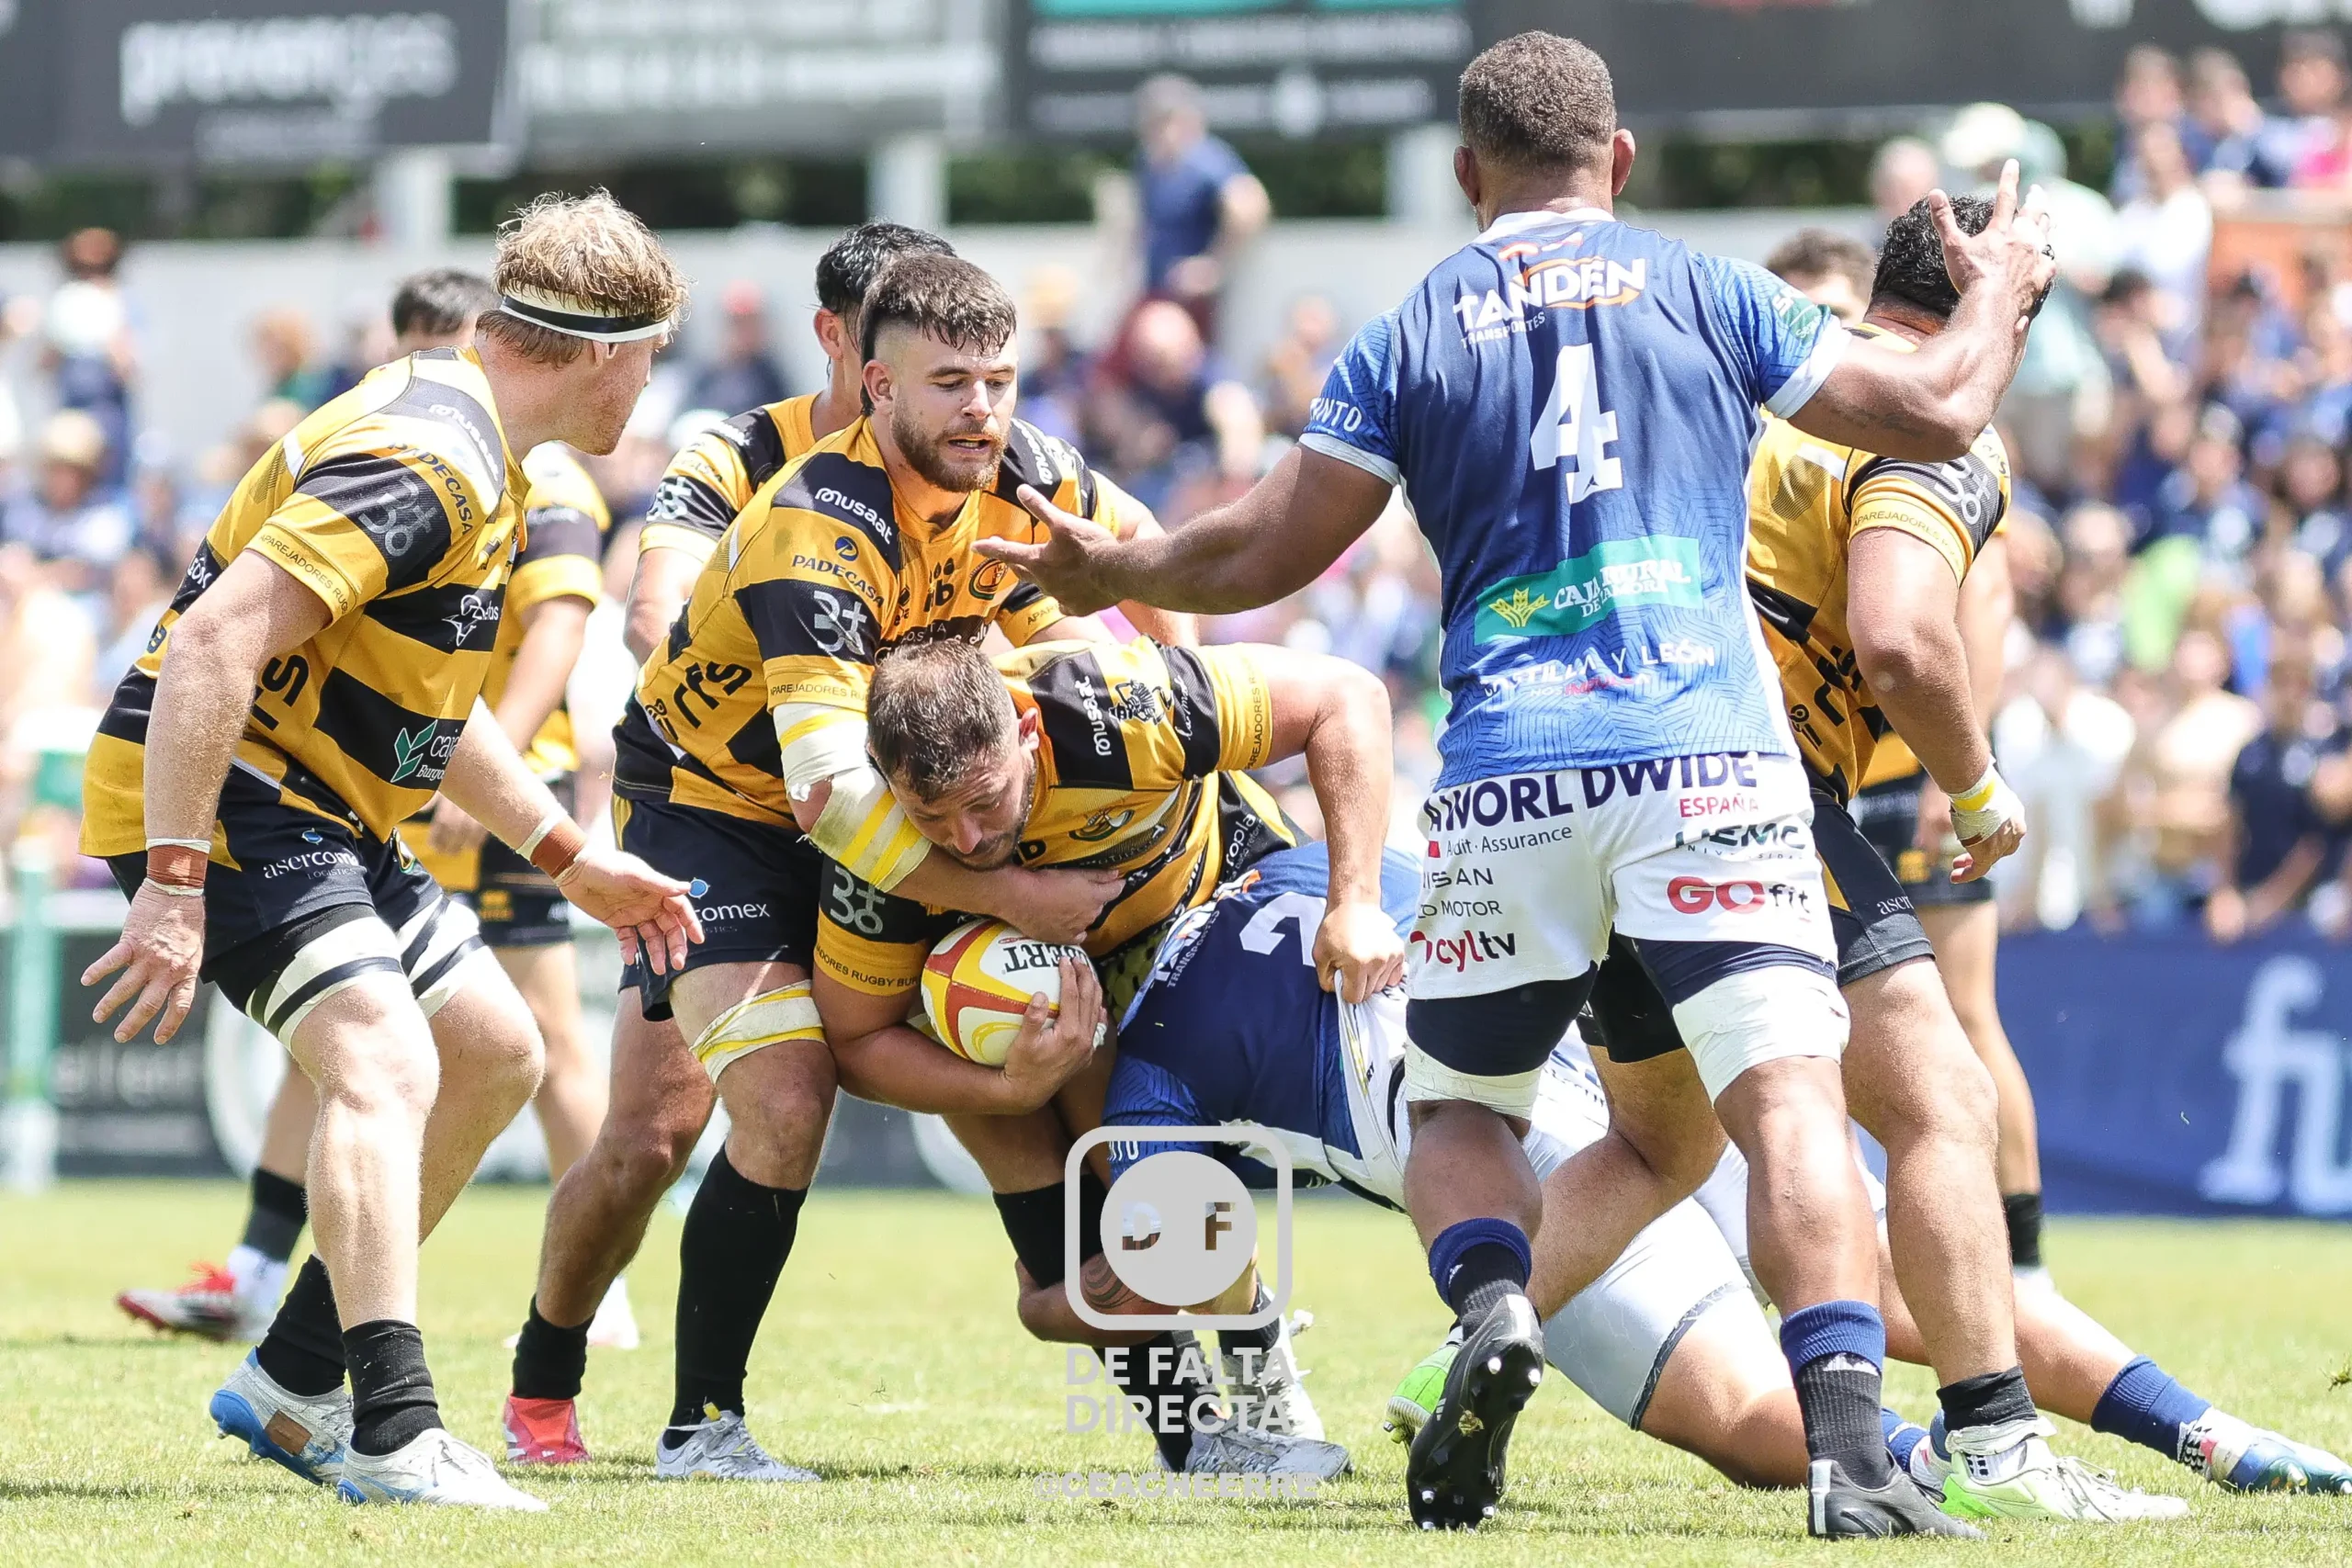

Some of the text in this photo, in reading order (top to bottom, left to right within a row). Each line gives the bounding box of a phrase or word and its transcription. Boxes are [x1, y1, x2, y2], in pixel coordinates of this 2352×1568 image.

[1453, 258, 1645, 333] TANDEN
[1461, 311, 1545, 349] TRANSPORTES
[1530, 343, 1623, 505] 4
[815, 487, 893, 545] musaat
[791, 555, 886, 608] PADECASA
[1600, 559, 1691, 589] RURAL
[1611, 648, 1627, 674] Y
[1641, 638, 1716, 667] LEÓN
[1679, 793, 1759, 818] ESPAÑA
[1481, 827, 1573, 853] Assurance
[308, 867, 358, 881] LOGISTICS
[1441, 900, 1504, 919] MOTOR
[851, 970, 896, 988] RUGBY
